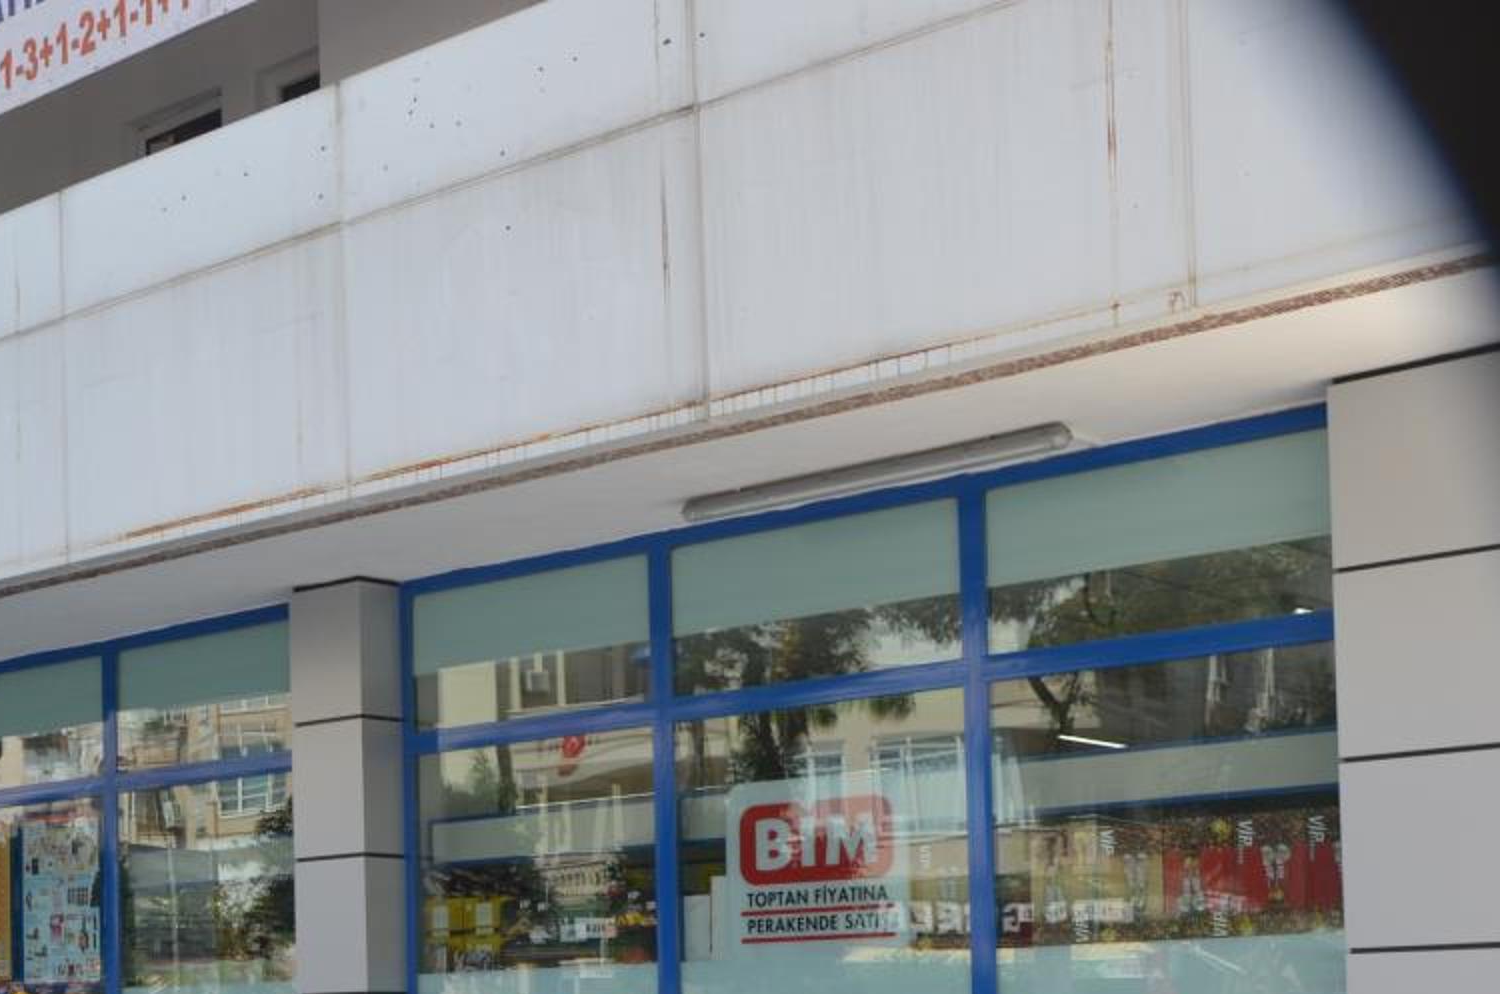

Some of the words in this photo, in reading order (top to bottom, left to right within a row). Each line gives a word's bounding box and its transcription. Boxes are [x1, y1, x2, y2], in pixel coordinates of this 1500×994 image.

[746, 889, 809, 908] TOPTAN
[814, 884, 888, 905] FİYATINA
[747, 914, 838, 934] PERAKENDE
[845, 911, 889, 931] SATI
